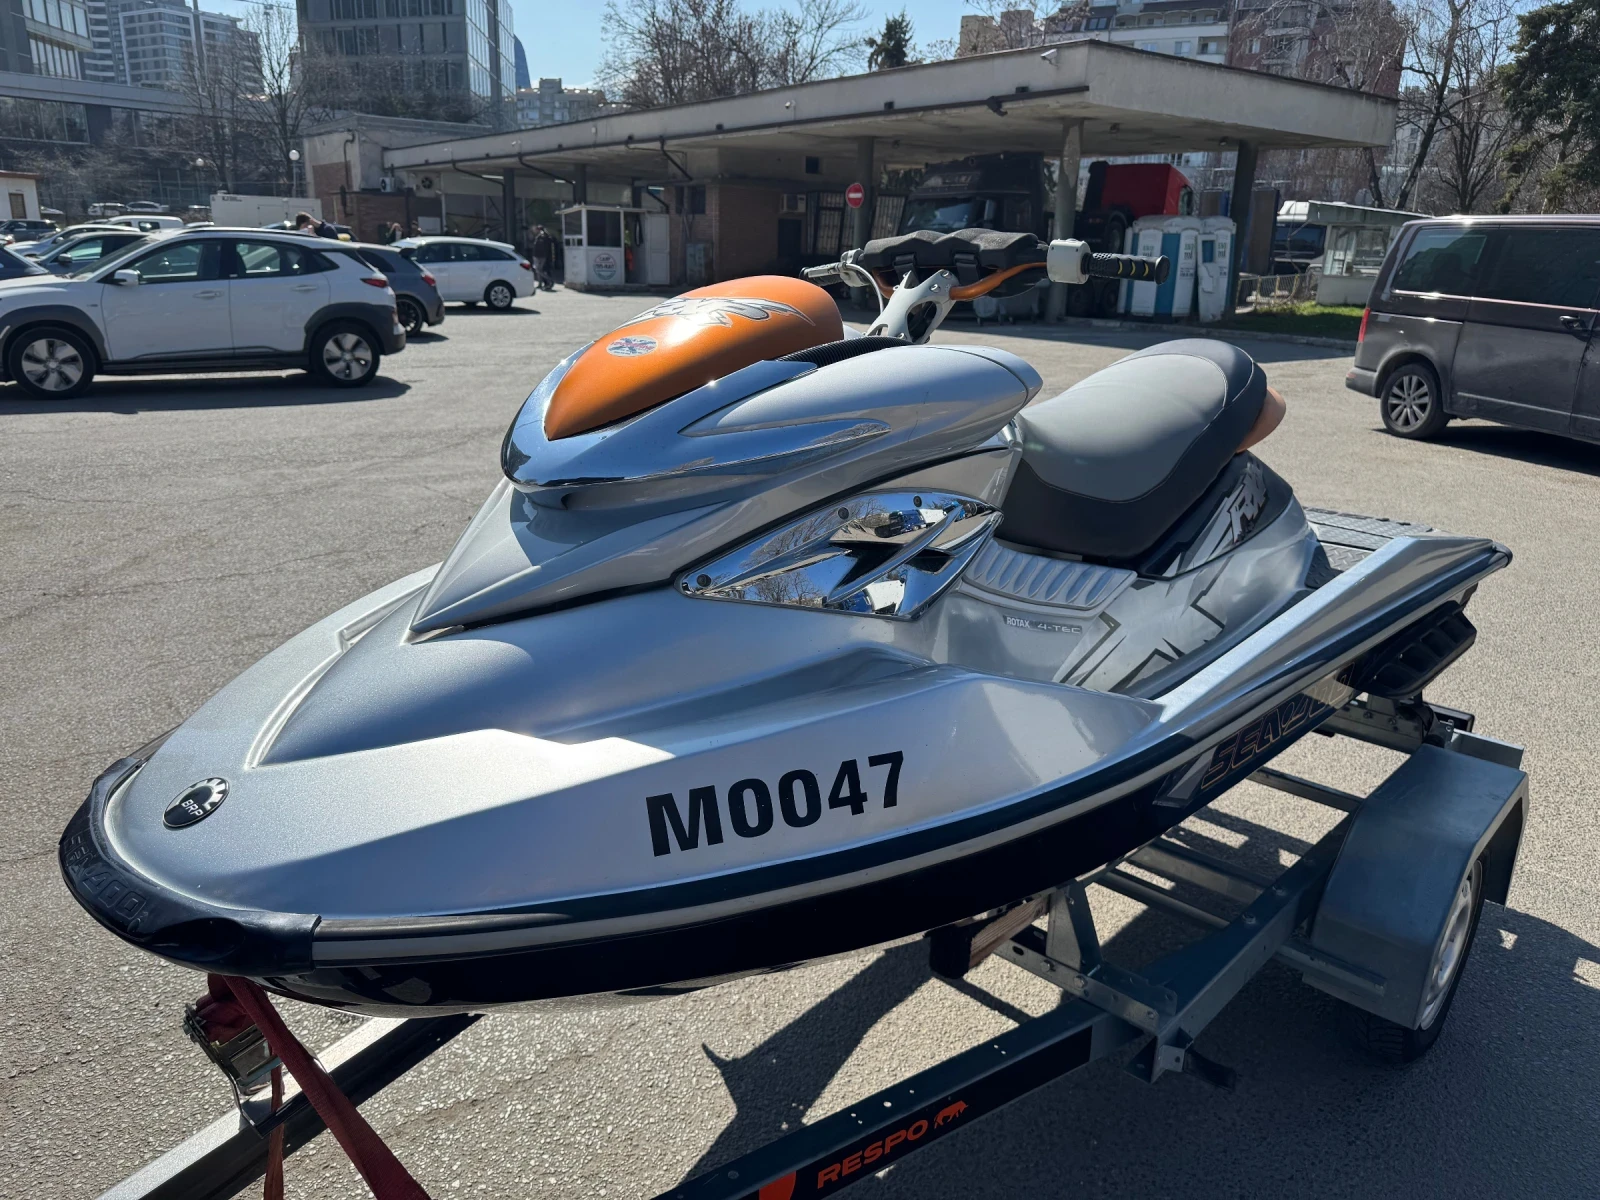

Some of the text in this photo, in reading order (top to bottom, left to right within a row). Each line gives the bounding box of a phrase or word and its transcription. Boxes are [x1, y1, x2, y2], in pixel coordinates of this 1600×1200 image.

[1006, 616, 1081, 634] ROTAX 4-TEC
[181, 799, 204, 816] BRP
[645, 750, 904, 857] M0047
[817, 1119, 929, 1189] RESPO
